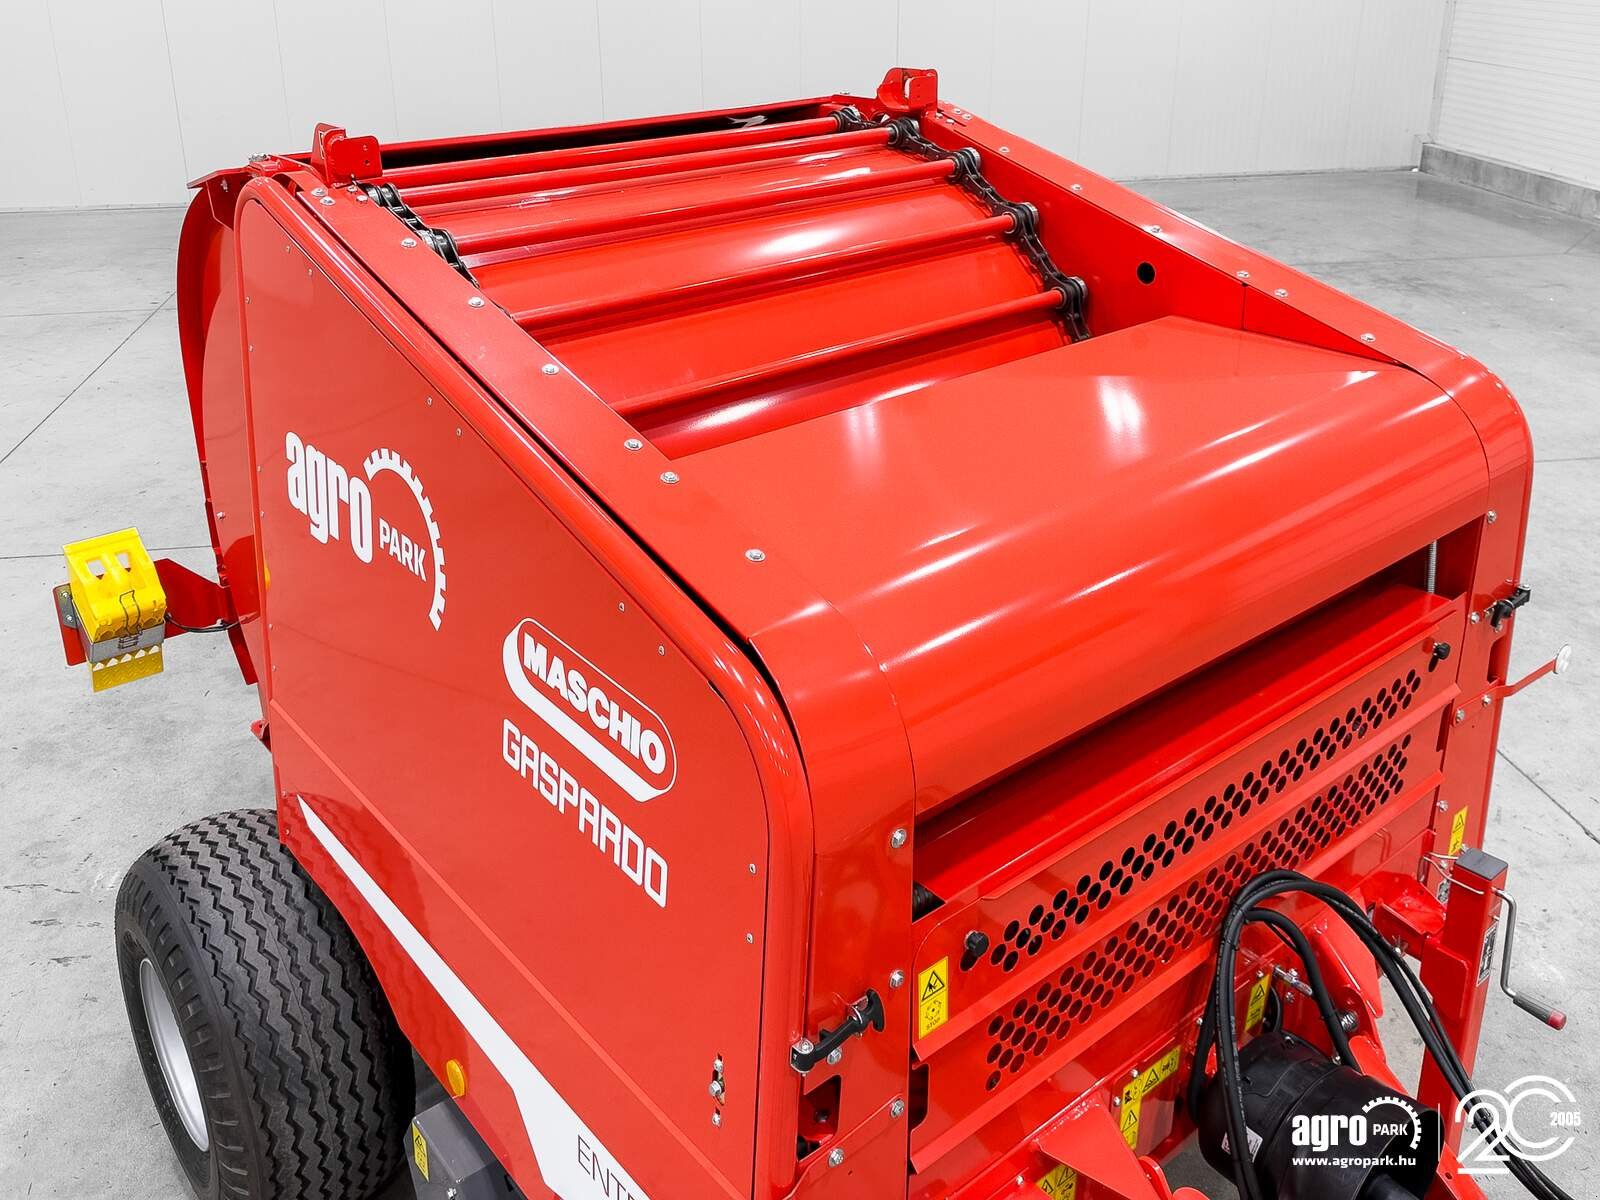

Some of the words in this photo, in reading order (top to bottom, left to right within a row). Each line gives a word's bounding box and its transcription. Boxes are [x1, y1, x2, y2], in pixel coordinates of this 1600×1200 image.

[285, 431, 373, 564] agro
[379, 517, 427, 583] PARK
[523, 632, 667, 775] MASCHIO
[502, 718, 668, 908] GASPARDO
[577, 1133, 636, 1200] ENT
